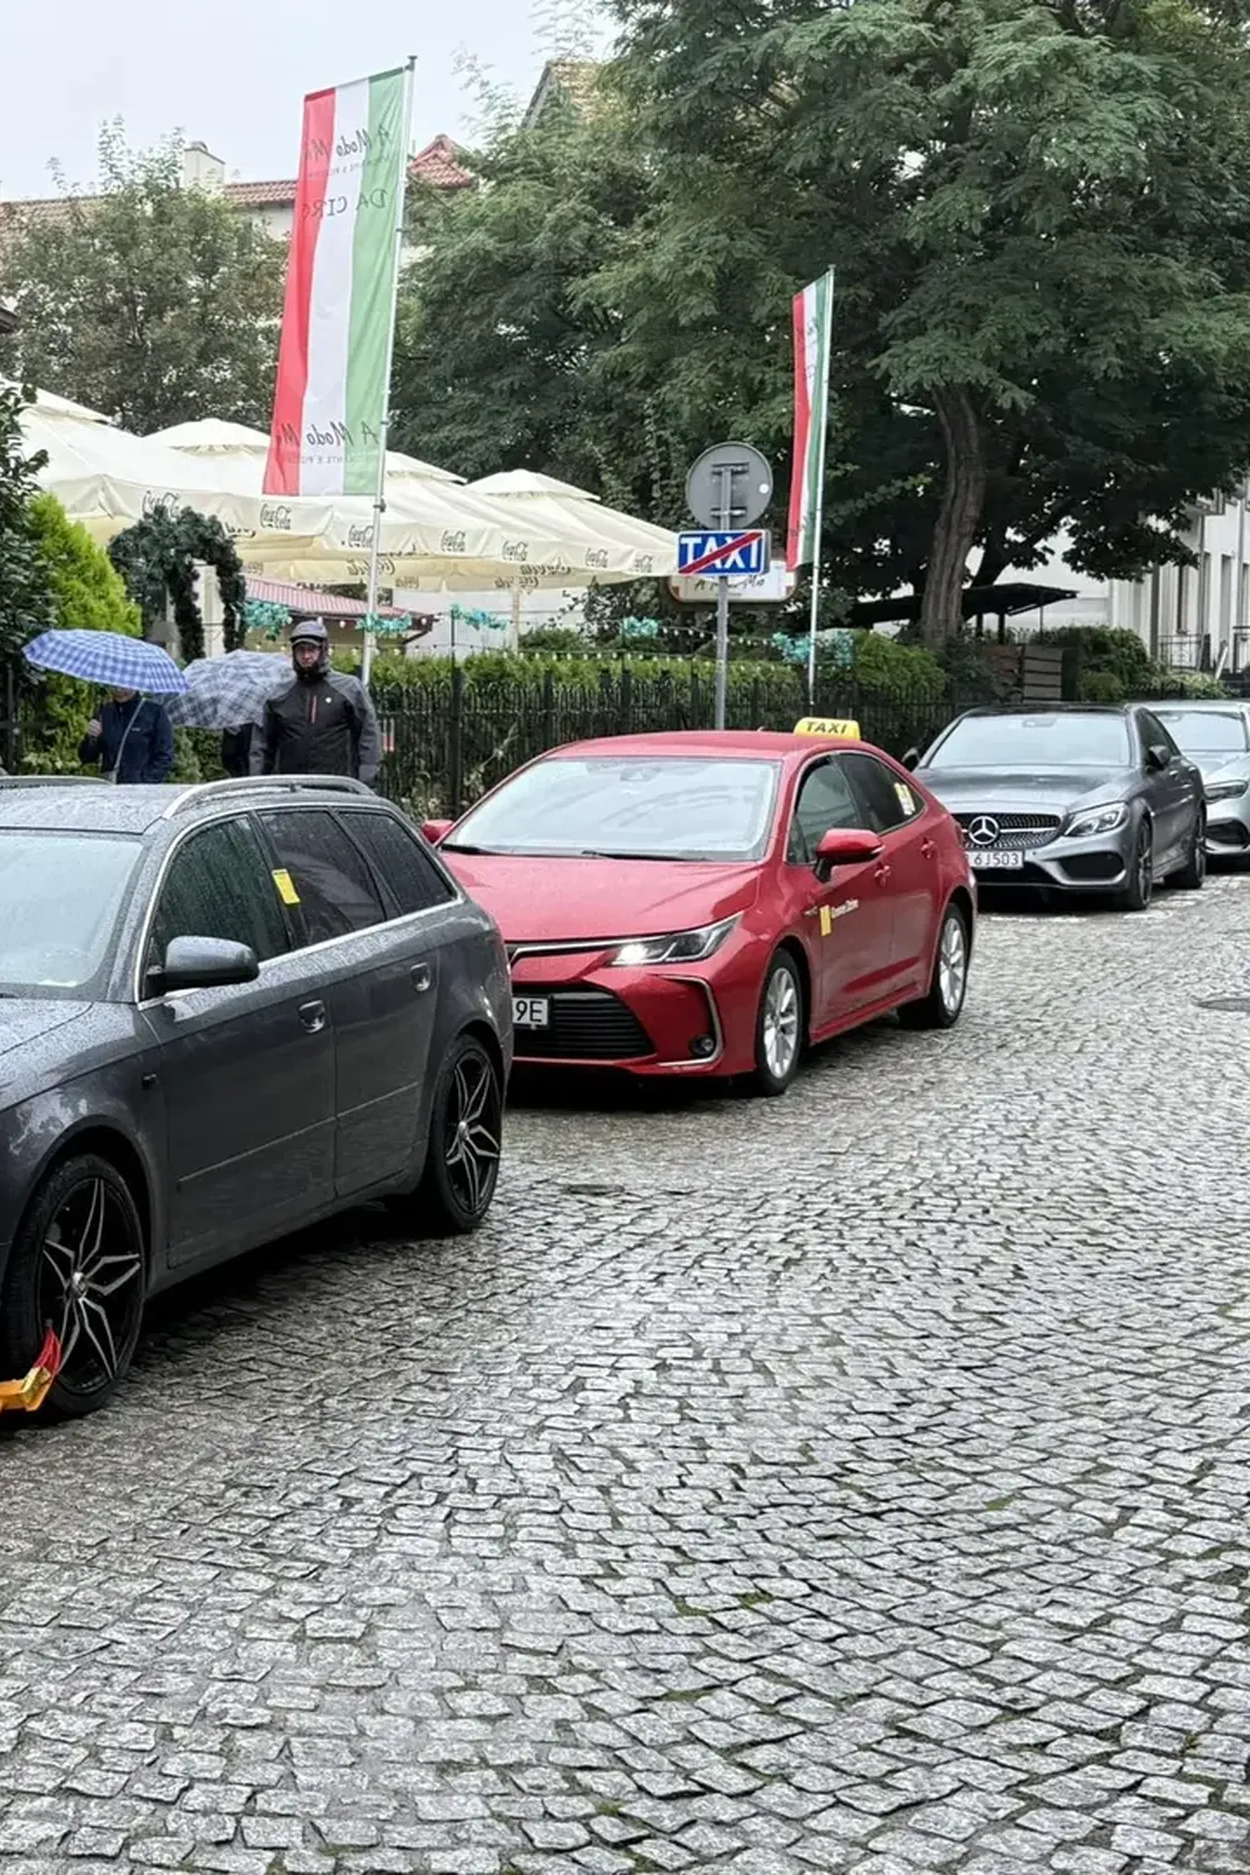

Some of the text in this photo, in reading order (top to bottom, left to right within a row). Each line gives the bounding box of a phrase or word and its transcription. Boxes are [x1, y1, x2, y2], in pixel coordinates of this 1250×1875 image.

[680, 535, 760, 569] TAXI
[806, 721, 848, 734] TAXI
[973, 852, 1020, 867] 6J503
[515, 1000, 543, 1022] 9E
